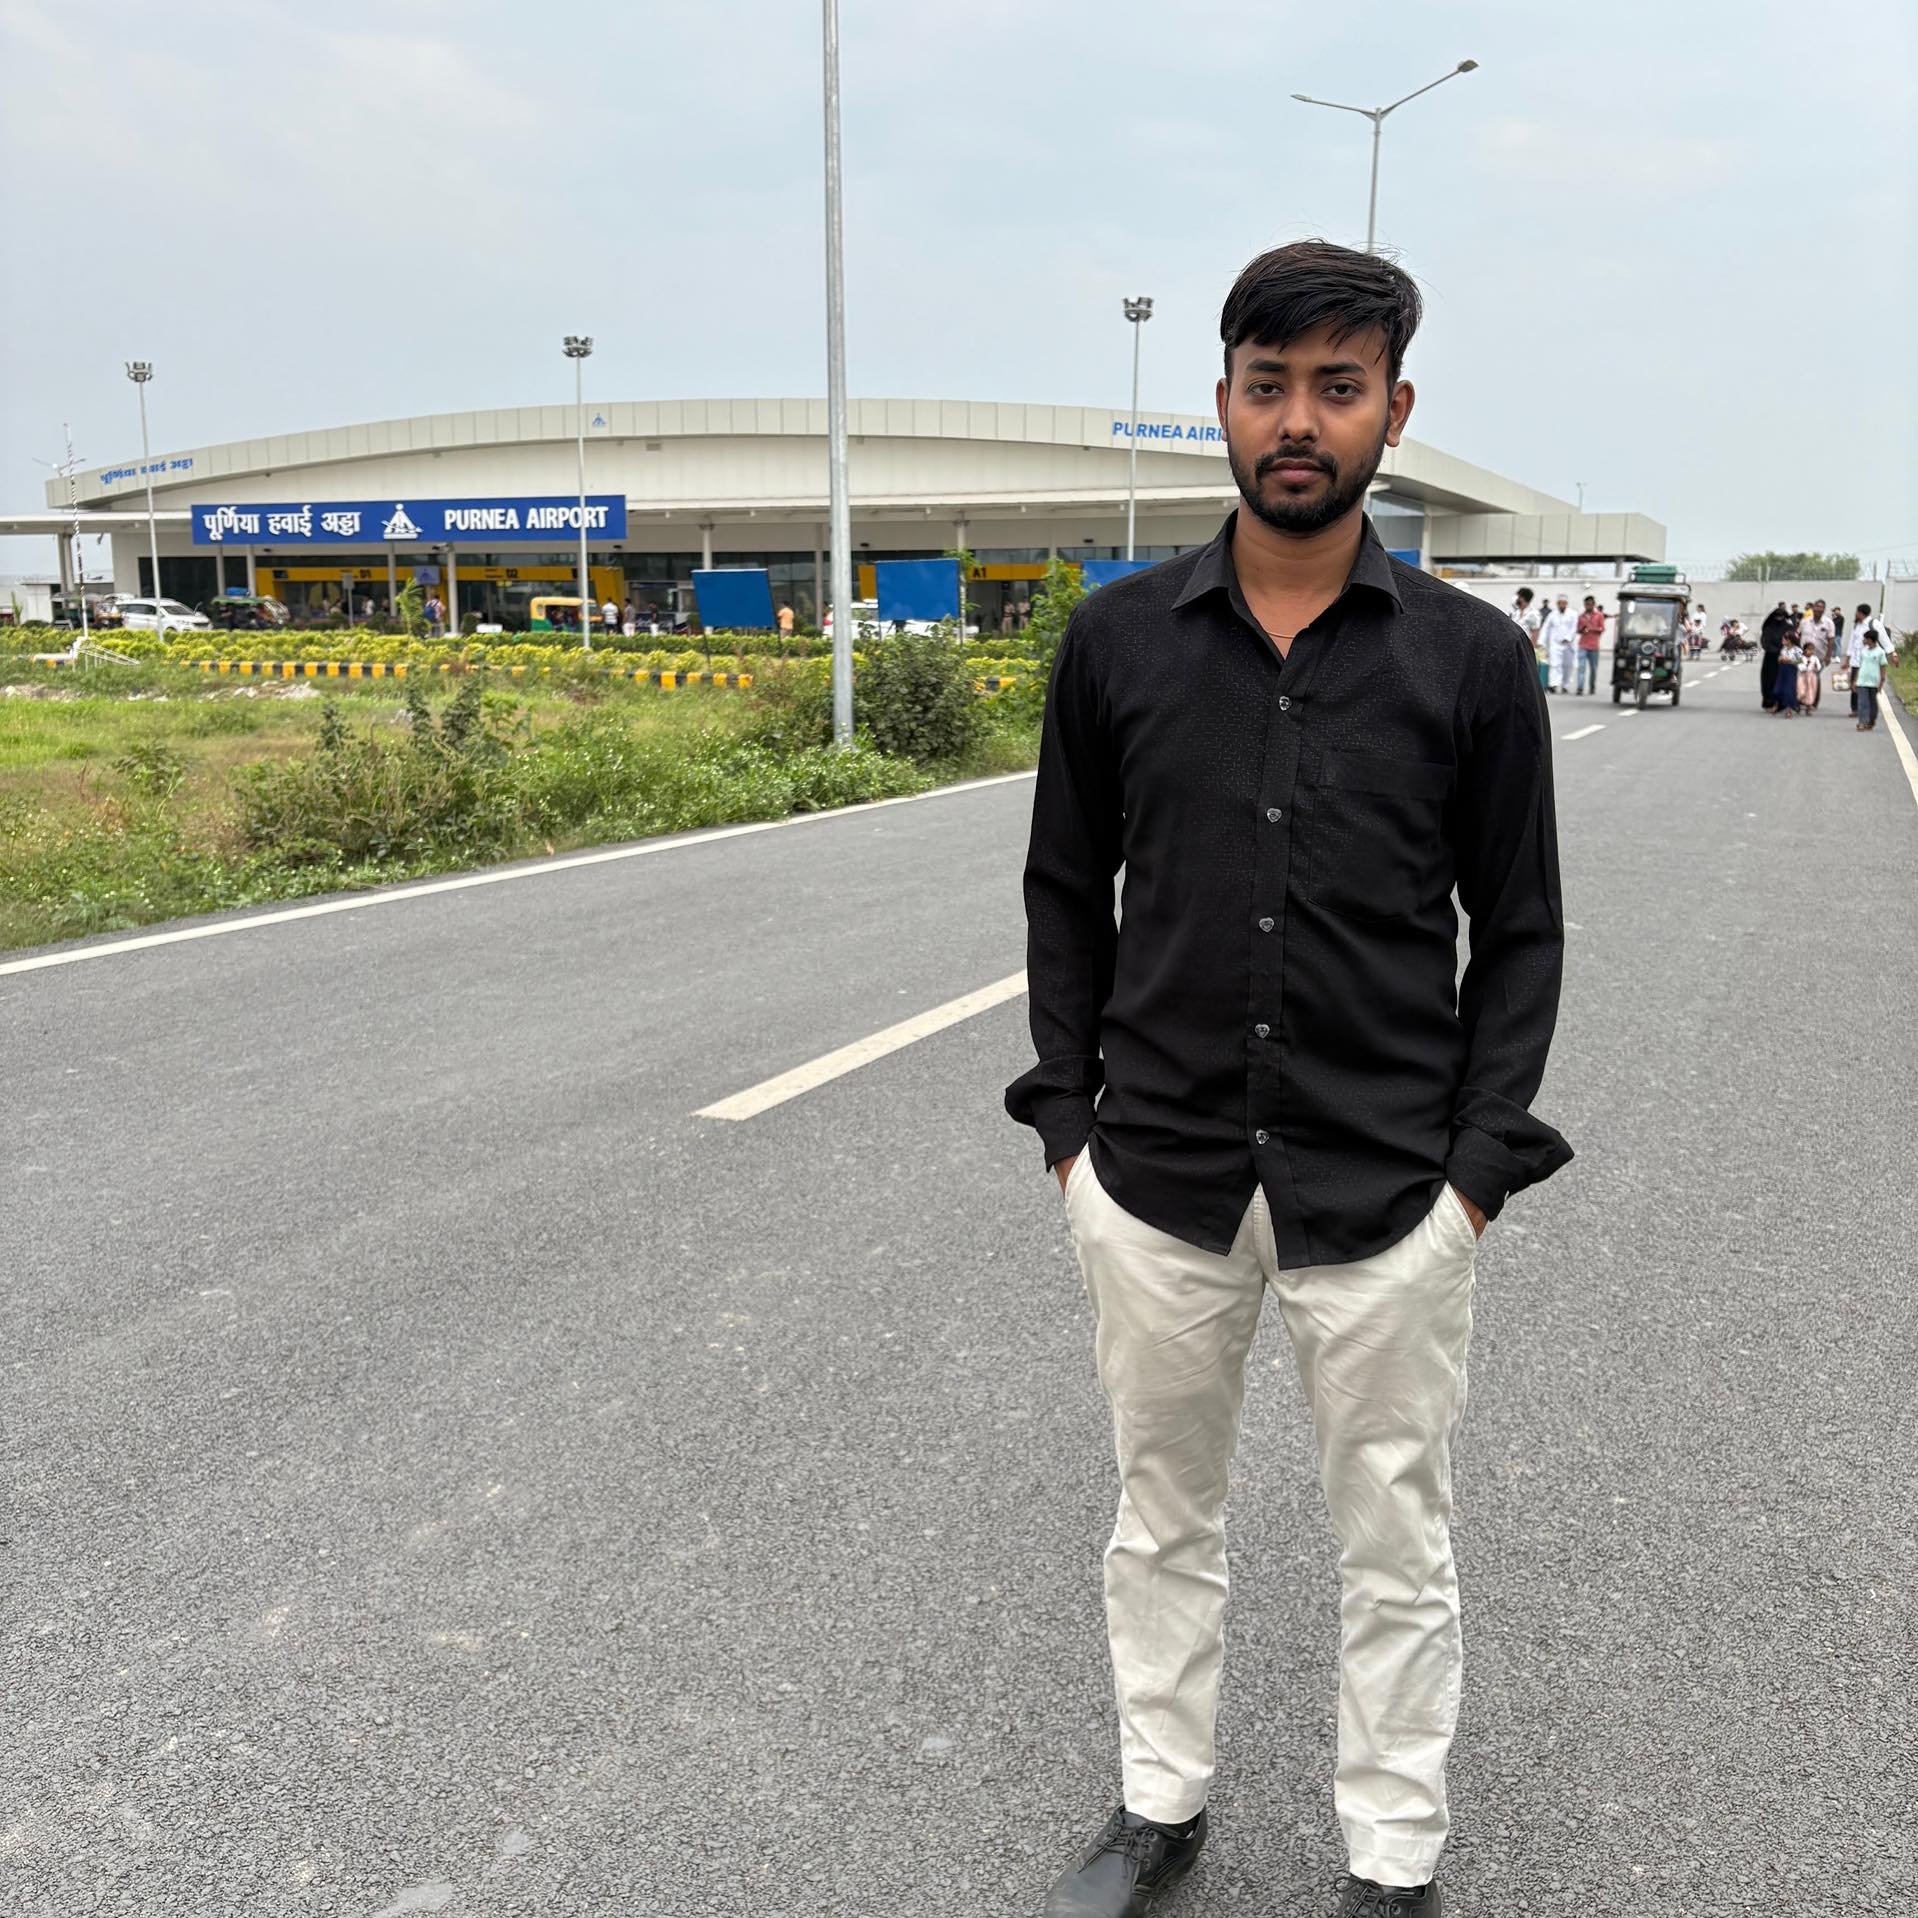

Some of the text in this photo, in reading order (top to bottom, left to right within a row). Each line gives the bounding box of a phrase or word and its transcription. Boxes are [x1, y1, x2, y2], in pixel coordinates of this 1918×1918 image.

[1112, 421, 1183, 439] PURNEA
[202, 504, 362, 541] पूर्णिया हवाई अड्डा
[444, 506, 609, 531] PURNEA AIRPORT
[972, 566, 987, 579] A1
